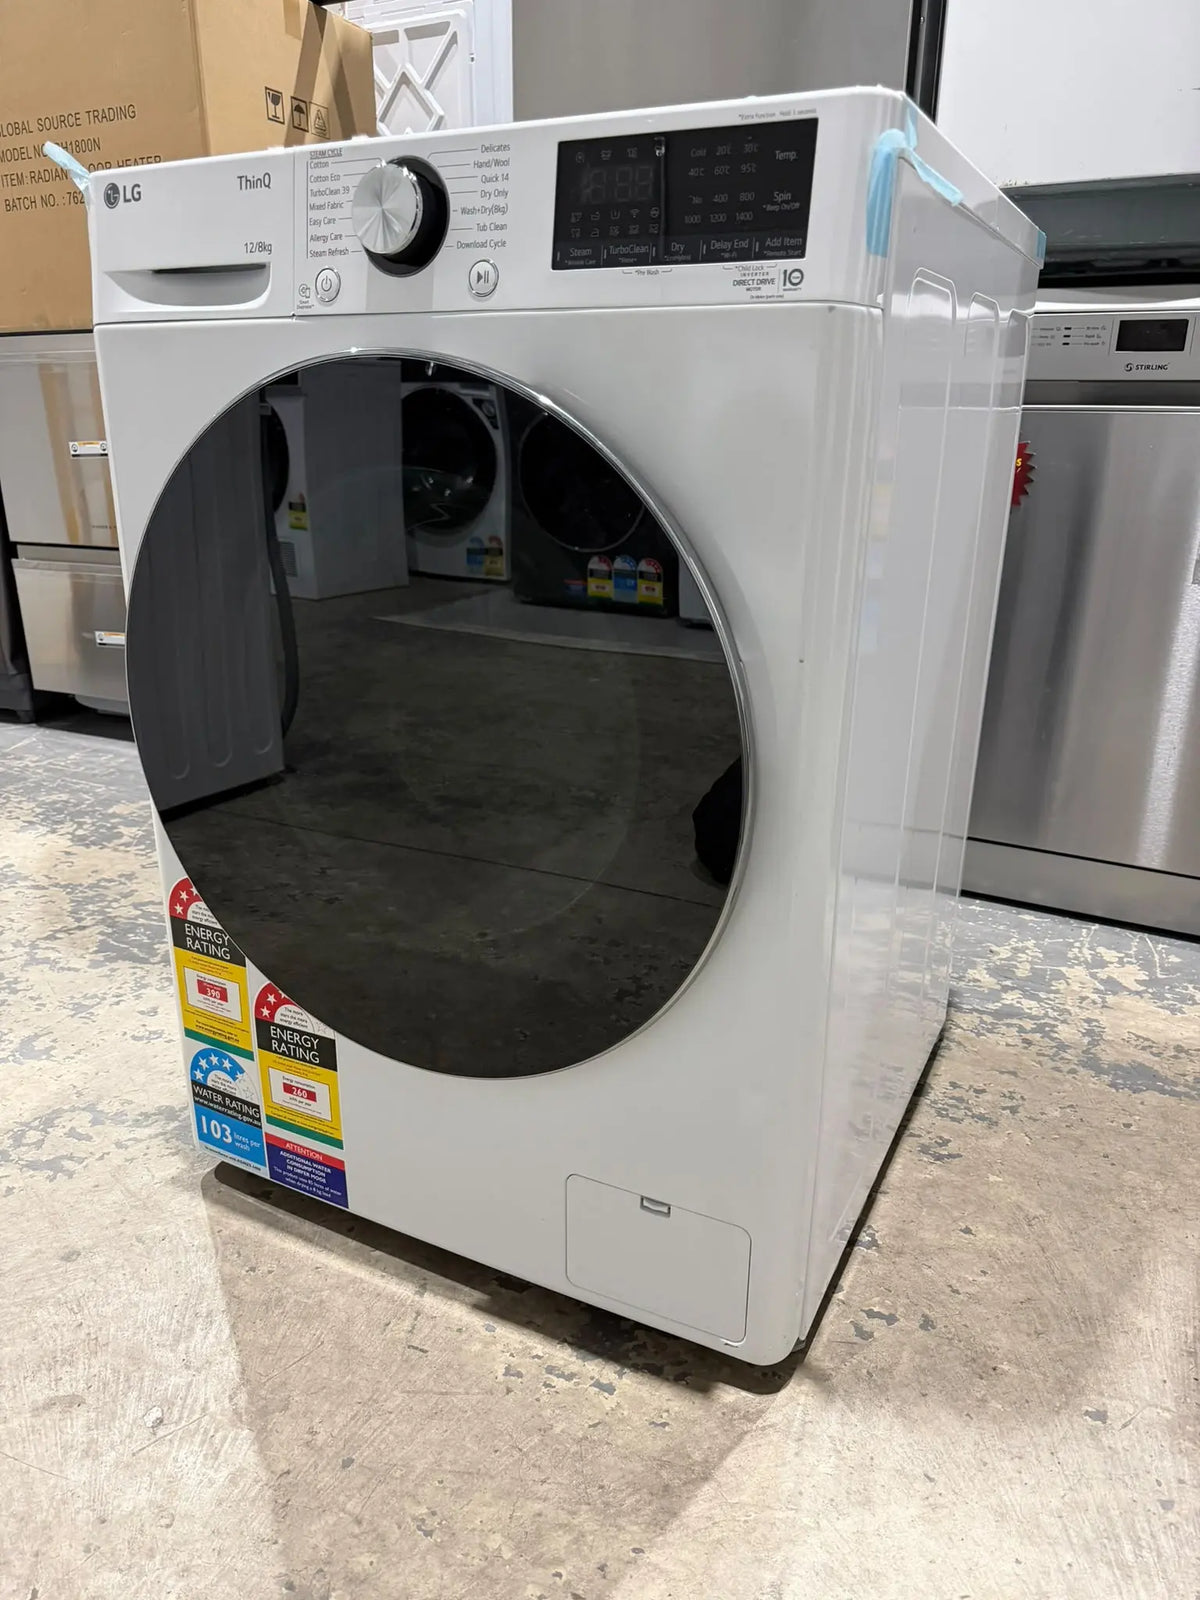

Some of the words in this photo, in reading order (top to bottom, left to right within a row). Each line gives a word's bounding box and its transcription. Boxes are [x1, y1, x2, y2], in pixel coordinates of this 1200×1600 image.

[0, 120, 34, 138] LOBAL
[37, 112, 82, 132] SOURCE
[85, 104, 137, 125] TRADING
[310, 149, 325, 157] STEAM
[326, 147, 343, 156] CYCLE
[481, 145, 511, 153] Delicates
[775, 150, 799, 162] Temp.
[310, 161, 329, 169] Cotton
[473, 158, 510, 168] Hand/Wool
[237, 172, 272, 191] ThinQ
[310, 175, 327, 183] Cotton
[481, 174, 500, 184] Quick
[501, 173, 510, 182] 14
[123, 183, 142, 203] LG
[310, 188, 341, 198] TurboClean
[342, 187, 350, 195] 39
[480, 190, 492, 199] Dry
[494, 189, 509, 199] Only
[713, 194, 728, 203] 400
[739, 192, 755, 201] 800
[774, 191, 792, 204] Spin
[5, 197, 37, 213] BATCH
[41, 194, 60, 208] NO.
[310, 202, 326, 211] Mixed
[328, 201, 344, 210] Fabric
[460, 203, 509, 216] Wash+Dry(8kg)
[309, 217, 322, 226] Easy
[323, 217, 337, 225] Care
[685, 214, 702, 224] 1000
[710, 213, 727, 223] 1200
[736, 211, 753, 222] 1400
[476, 223, 488, 232] Tub
[489, 223, 508, 231] Clean
[310, 234, 329, 244] Allergy
[330, 233, 343, 241] Care
[710, 240, 731, 251] Delay
[734, 238, 749, 248] End
[765, 238, 782, 247] Add
[784, 237, 803, 246] Item
[244, 241, 273, 255] 12/8kg
[457, 241, 488, 251] Download
[489, 240, 507, 249] Cycle
[609, 245, 649, 255] TurboClean
[671, 242, 685, 253] Dry
[310, 249, 327, 258] Steam
[328, 247, 349, 257] Refresh
[570, 248, 593, 257] Steam
[732, 278, 756, 287] DIRECT
[756, 277, 776, 286] DRIVE
[1135, 363, 1169, 371] STIRLING
[184, 922, 231, 946] ENERGY
[186, 937, 231, 961] RATING
[206, 987, 221, 999] 390
[270, 1025, 320, 1050] ENERGY
[271, 1038, 320, 1064] RATING
[291, 1086, 308, 1099] 260
[192, 1084, 224, 1105] WATER
[224, 1094, 261, 1119] RATING
[200, 1114, 233, 1144] 103
[233, 1130, 250, 1144] litres
[250, 1138, 261, 1149] per
[234, 1140, 251, 1152] wash
[285, 1139, 323, 1161] ATTENTION
[286, 1159, 326, 1178] CONSUMPTION
[312, 1161, 332, 1174] WATER
